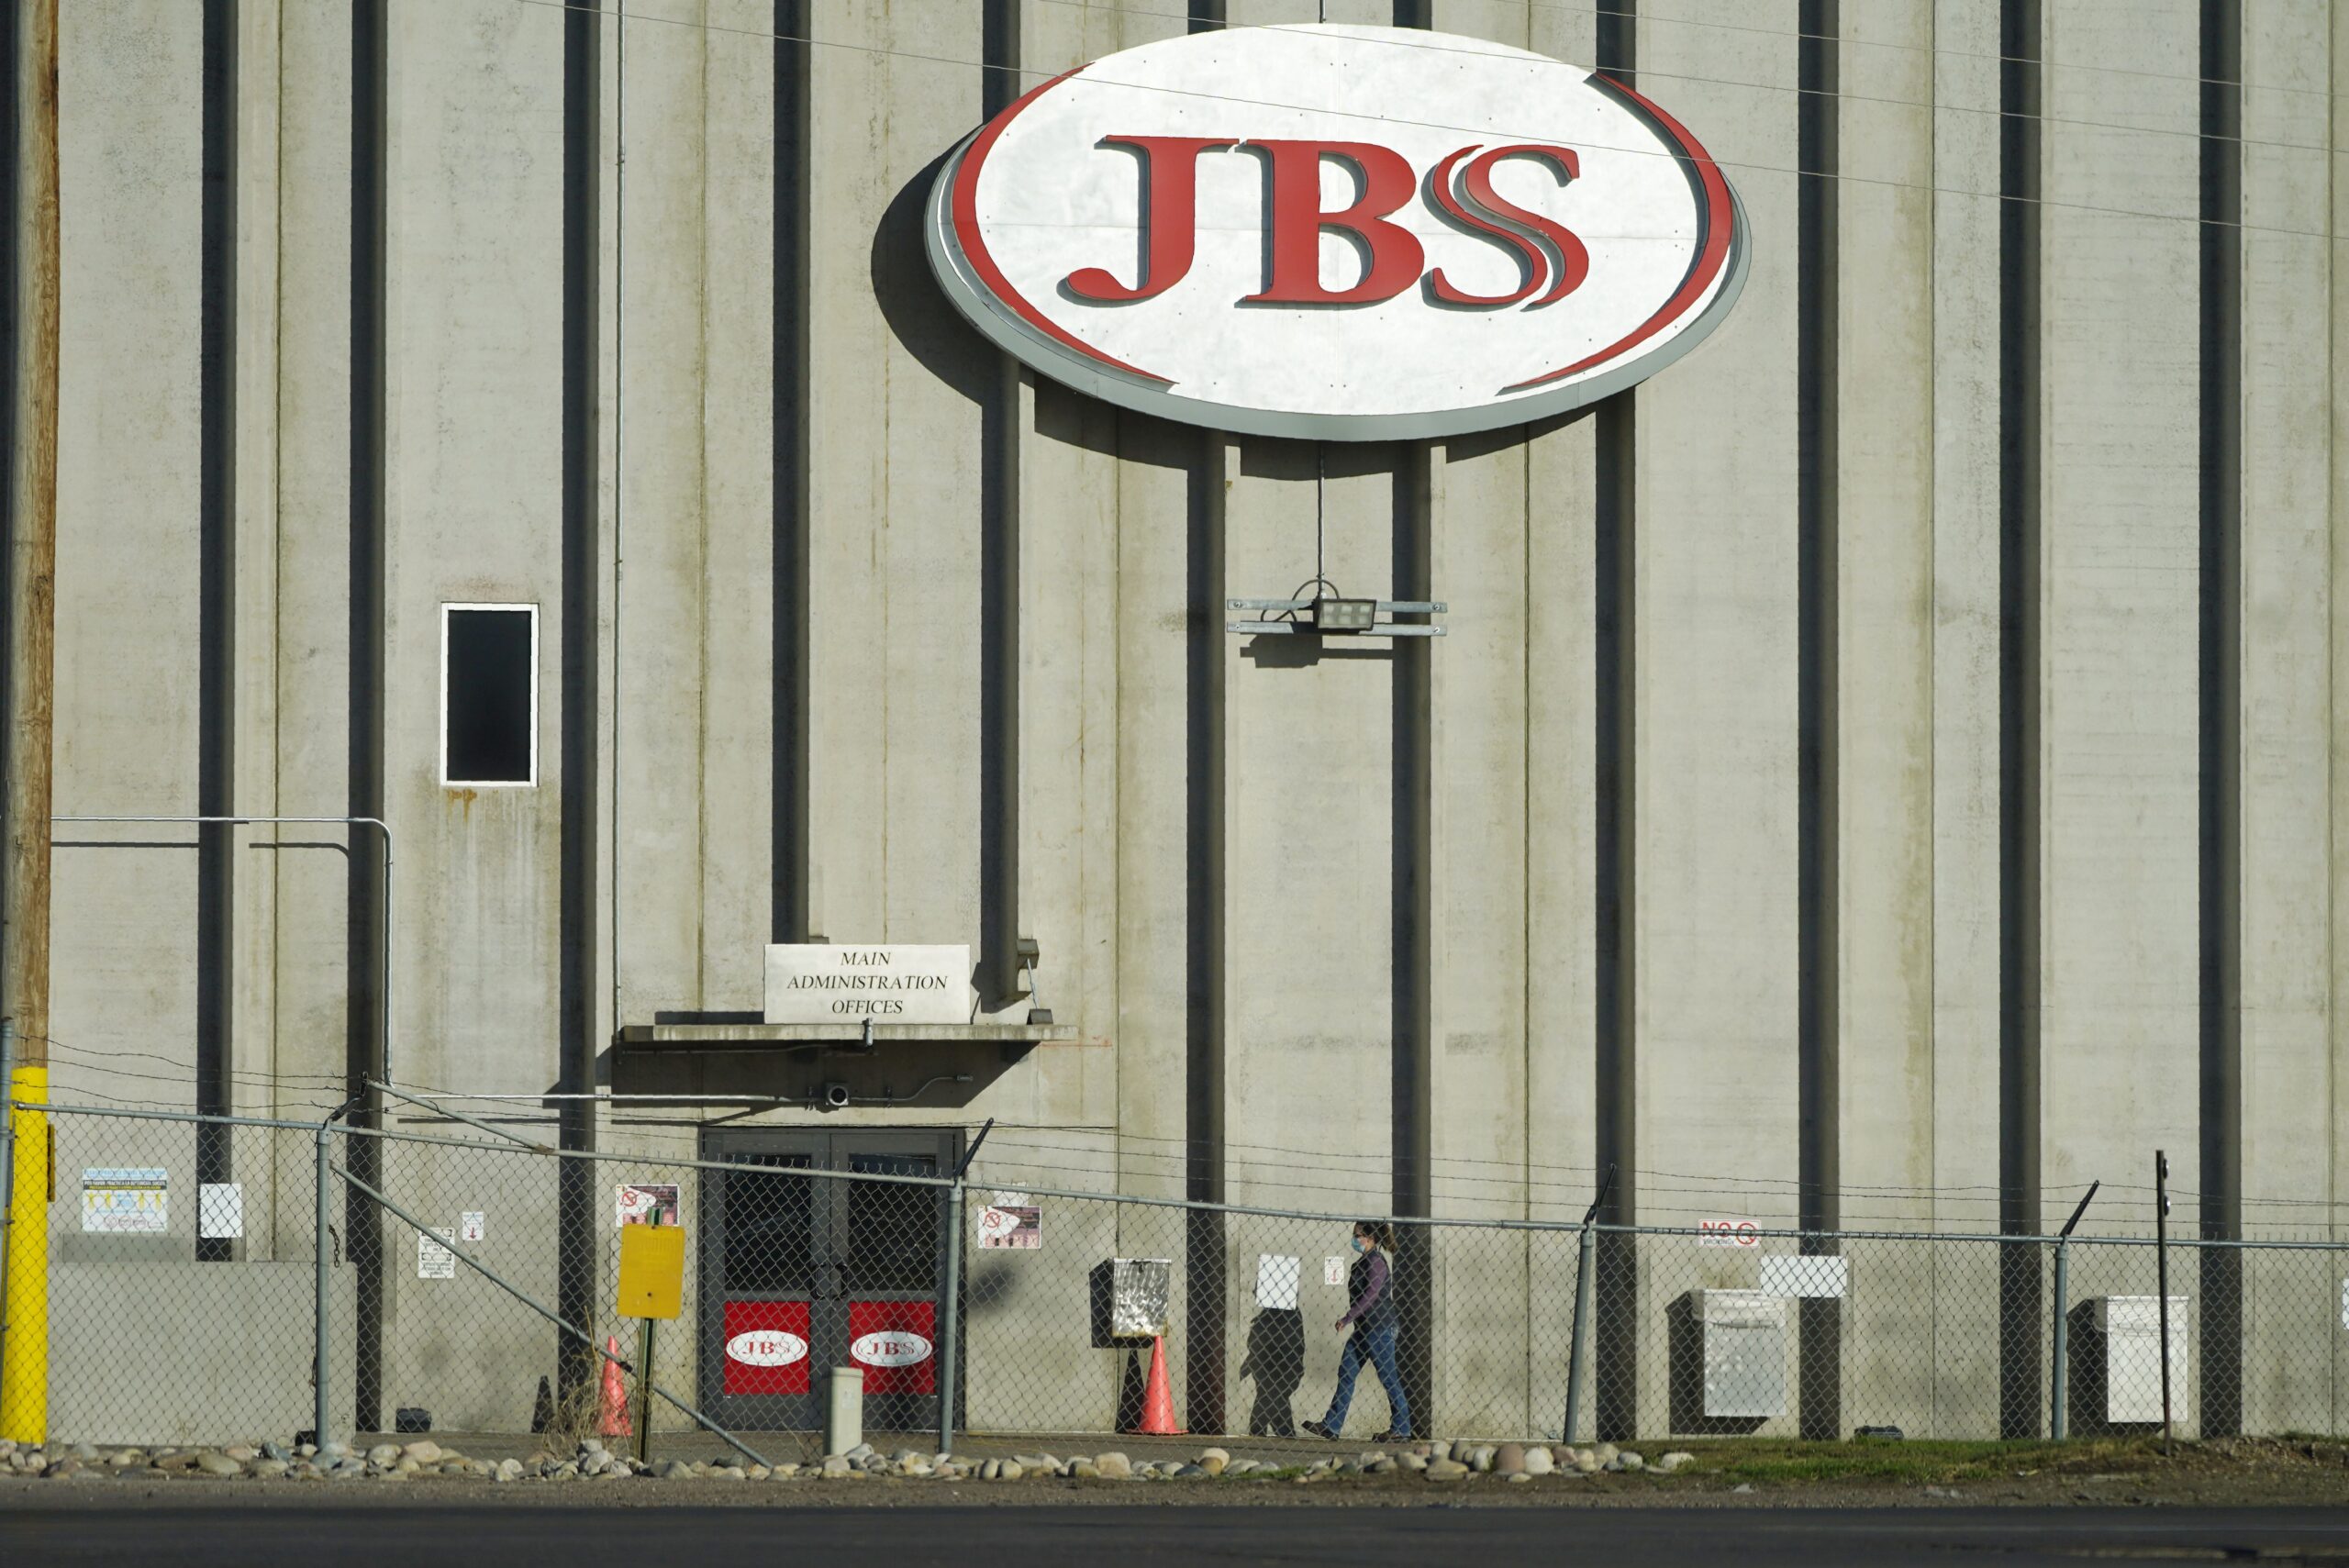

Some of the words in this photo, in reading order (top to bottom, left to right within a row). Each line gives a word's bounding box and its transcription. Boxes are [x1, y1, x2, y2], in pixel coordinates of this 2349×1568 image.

[1064, 134, 1589, 307] JBS
[841, 951, 891, 965] MAIN
[786, 974, 948, 990] ADMINISTRATION
[831, 998, 903, 1015] OFFICES
[1702, 1222, 1731, 1237] NO
[742, 1340, 791, 1355] JBS
[867, 1341, 915, 1355] JBS
